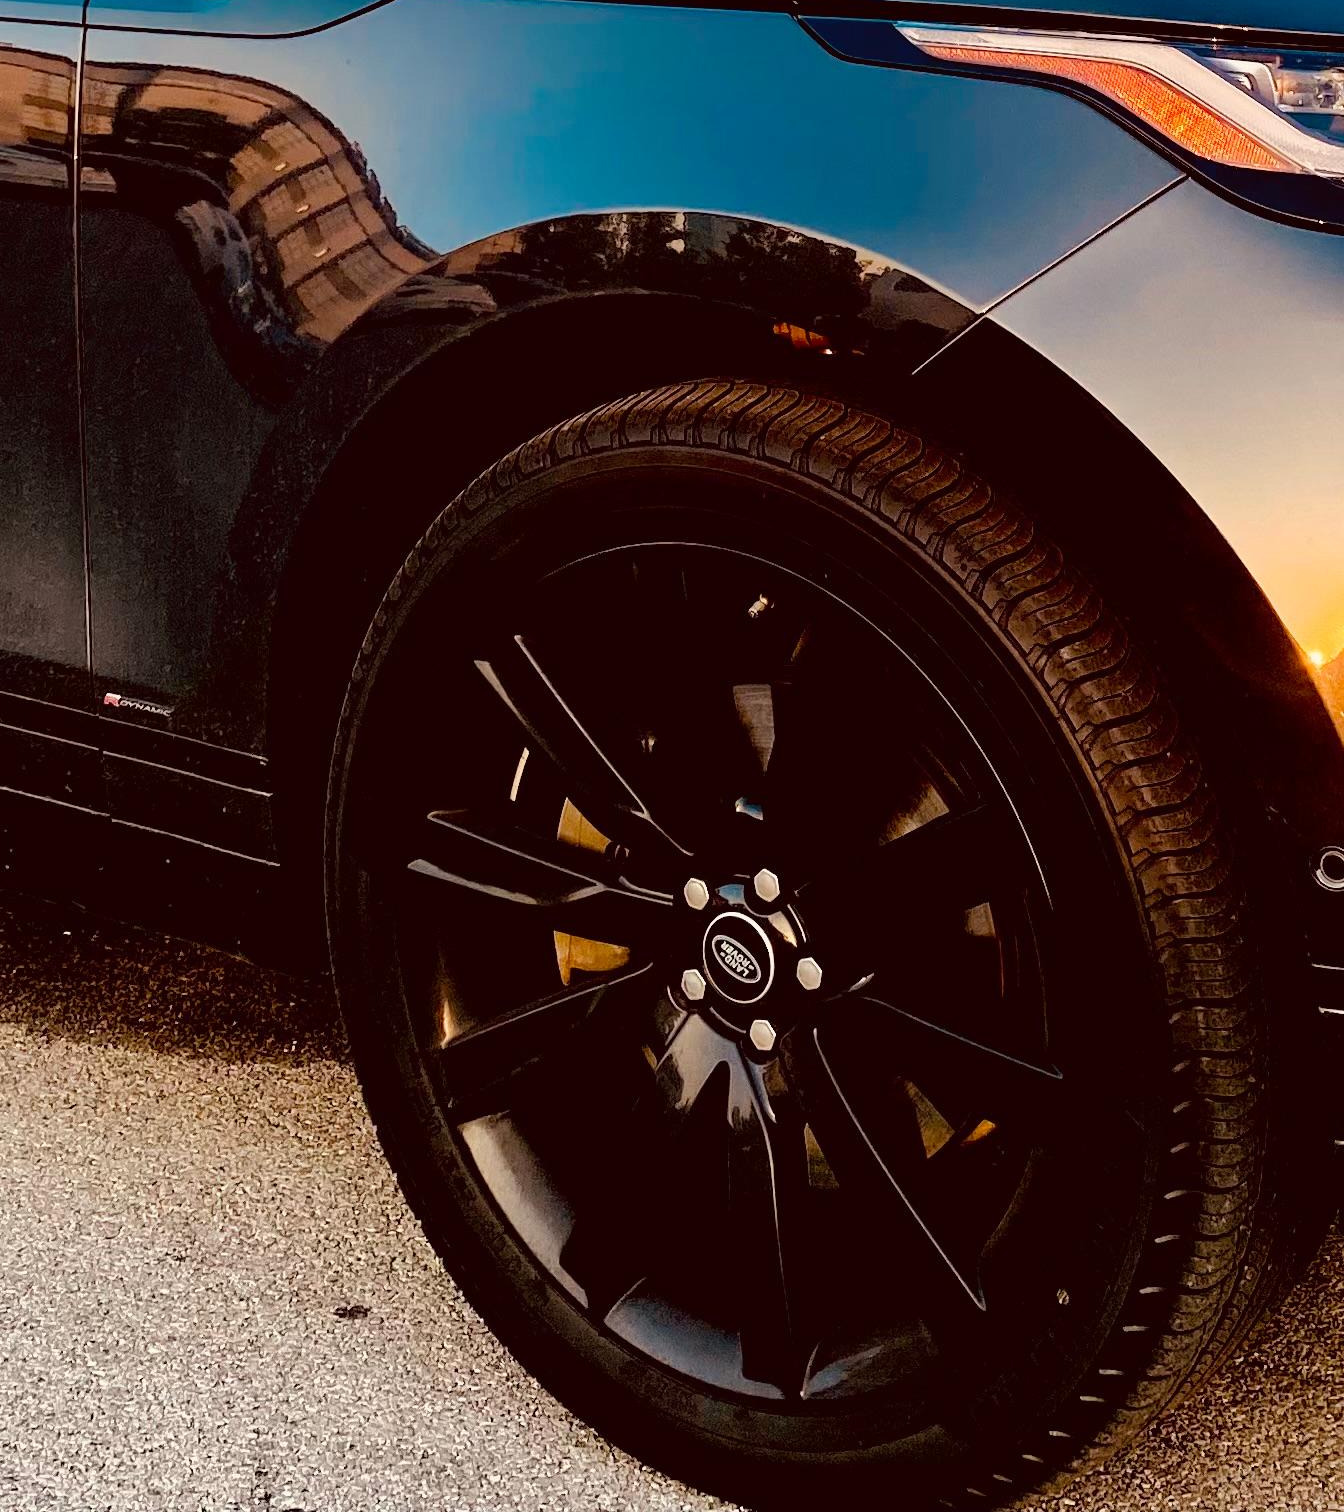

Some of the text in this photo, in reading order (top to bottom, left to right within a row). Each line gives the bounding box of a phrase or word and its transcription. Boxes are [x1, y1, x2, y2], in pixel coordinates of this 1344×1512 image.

[120, 699, 172, 717] DYNAMIC
[720, 940, 751, 968] ROVER
[724, 954, 750, 978] LAND
